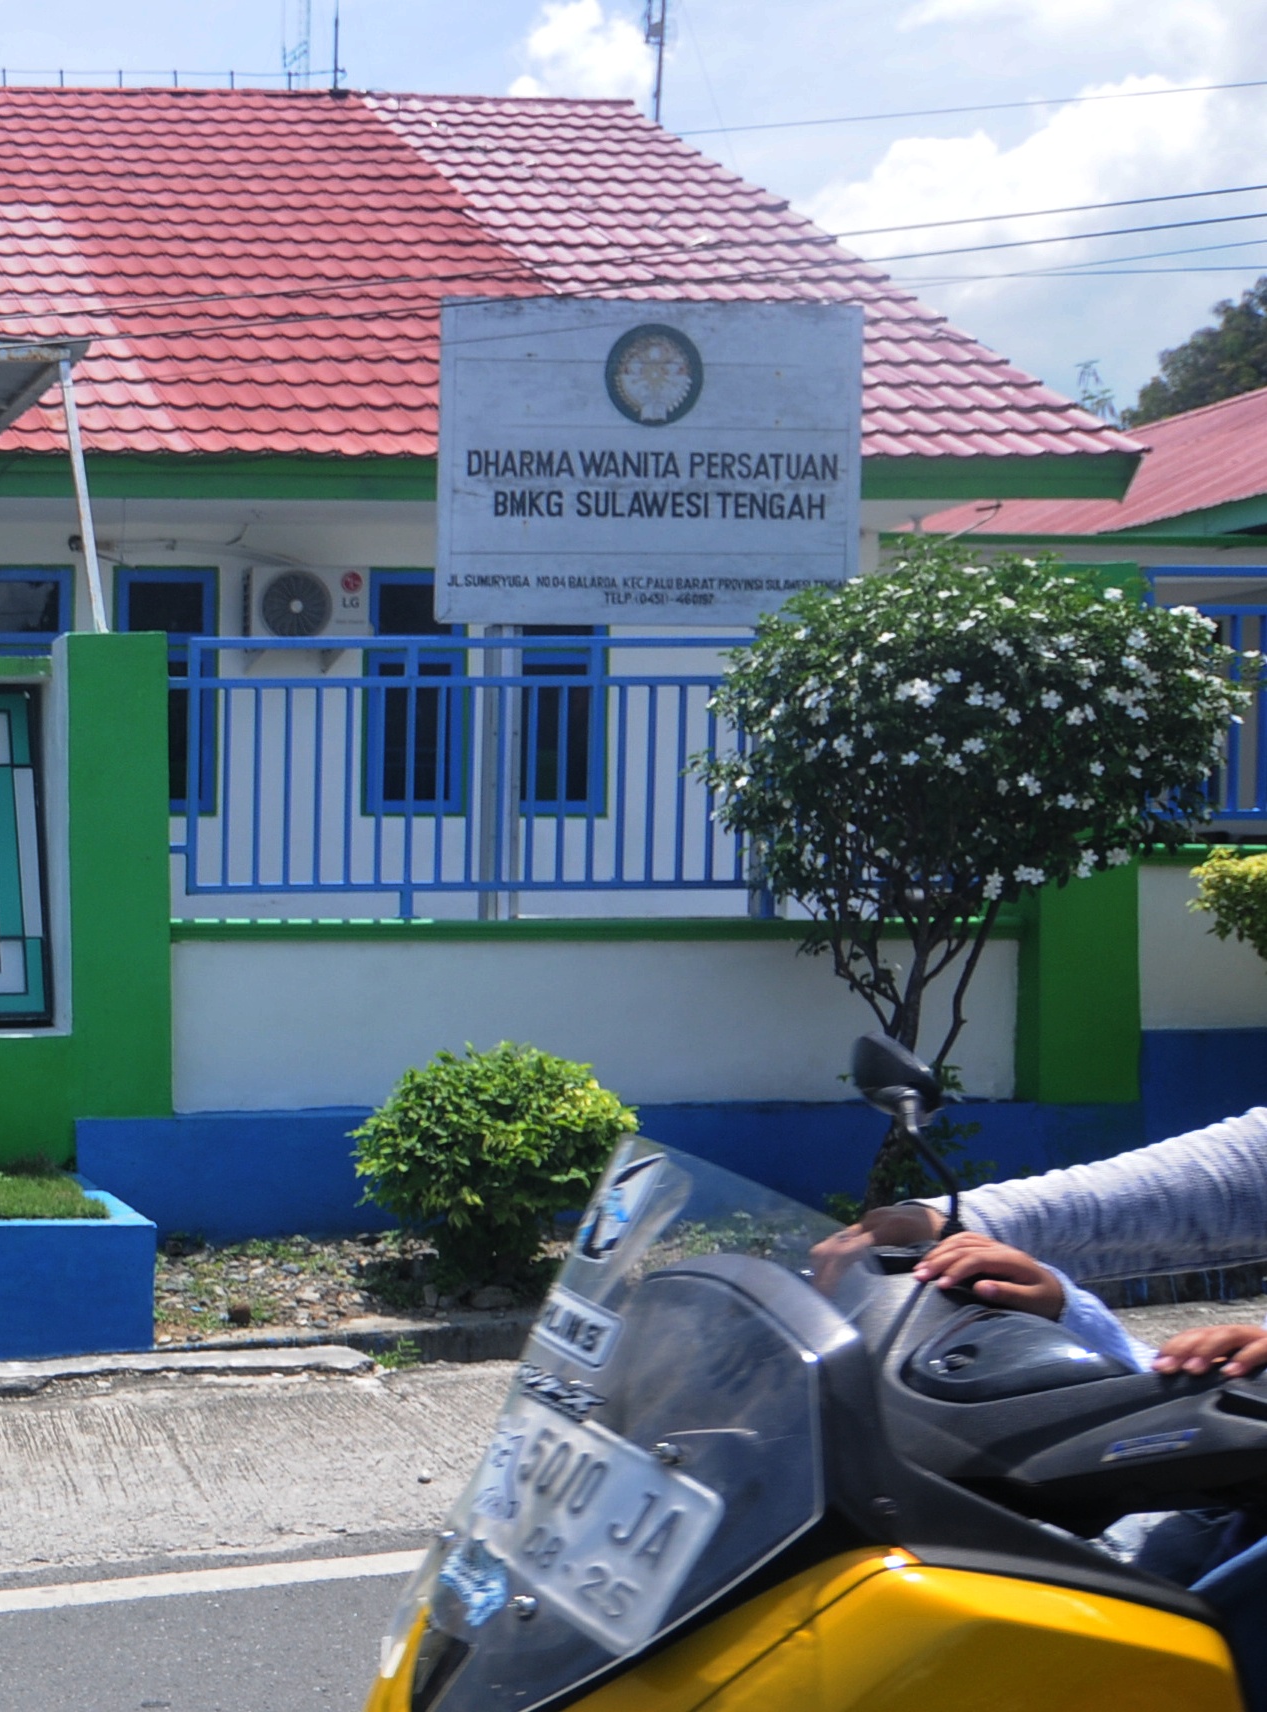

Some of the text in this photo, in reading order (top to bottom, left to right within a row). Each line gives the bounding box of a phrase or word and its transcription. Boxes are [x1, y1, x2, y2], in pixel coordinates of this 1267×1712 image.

[467, 450, 838, 482] DHARMA WANITA PERSATUAN
[493, 490, 825, 520] BMKG SULAWESI TENGAH
[676, 578, 715, 590] BARAT
[342, 597, 360, 609] LG
[607, 1492, 687, 1571] JA
